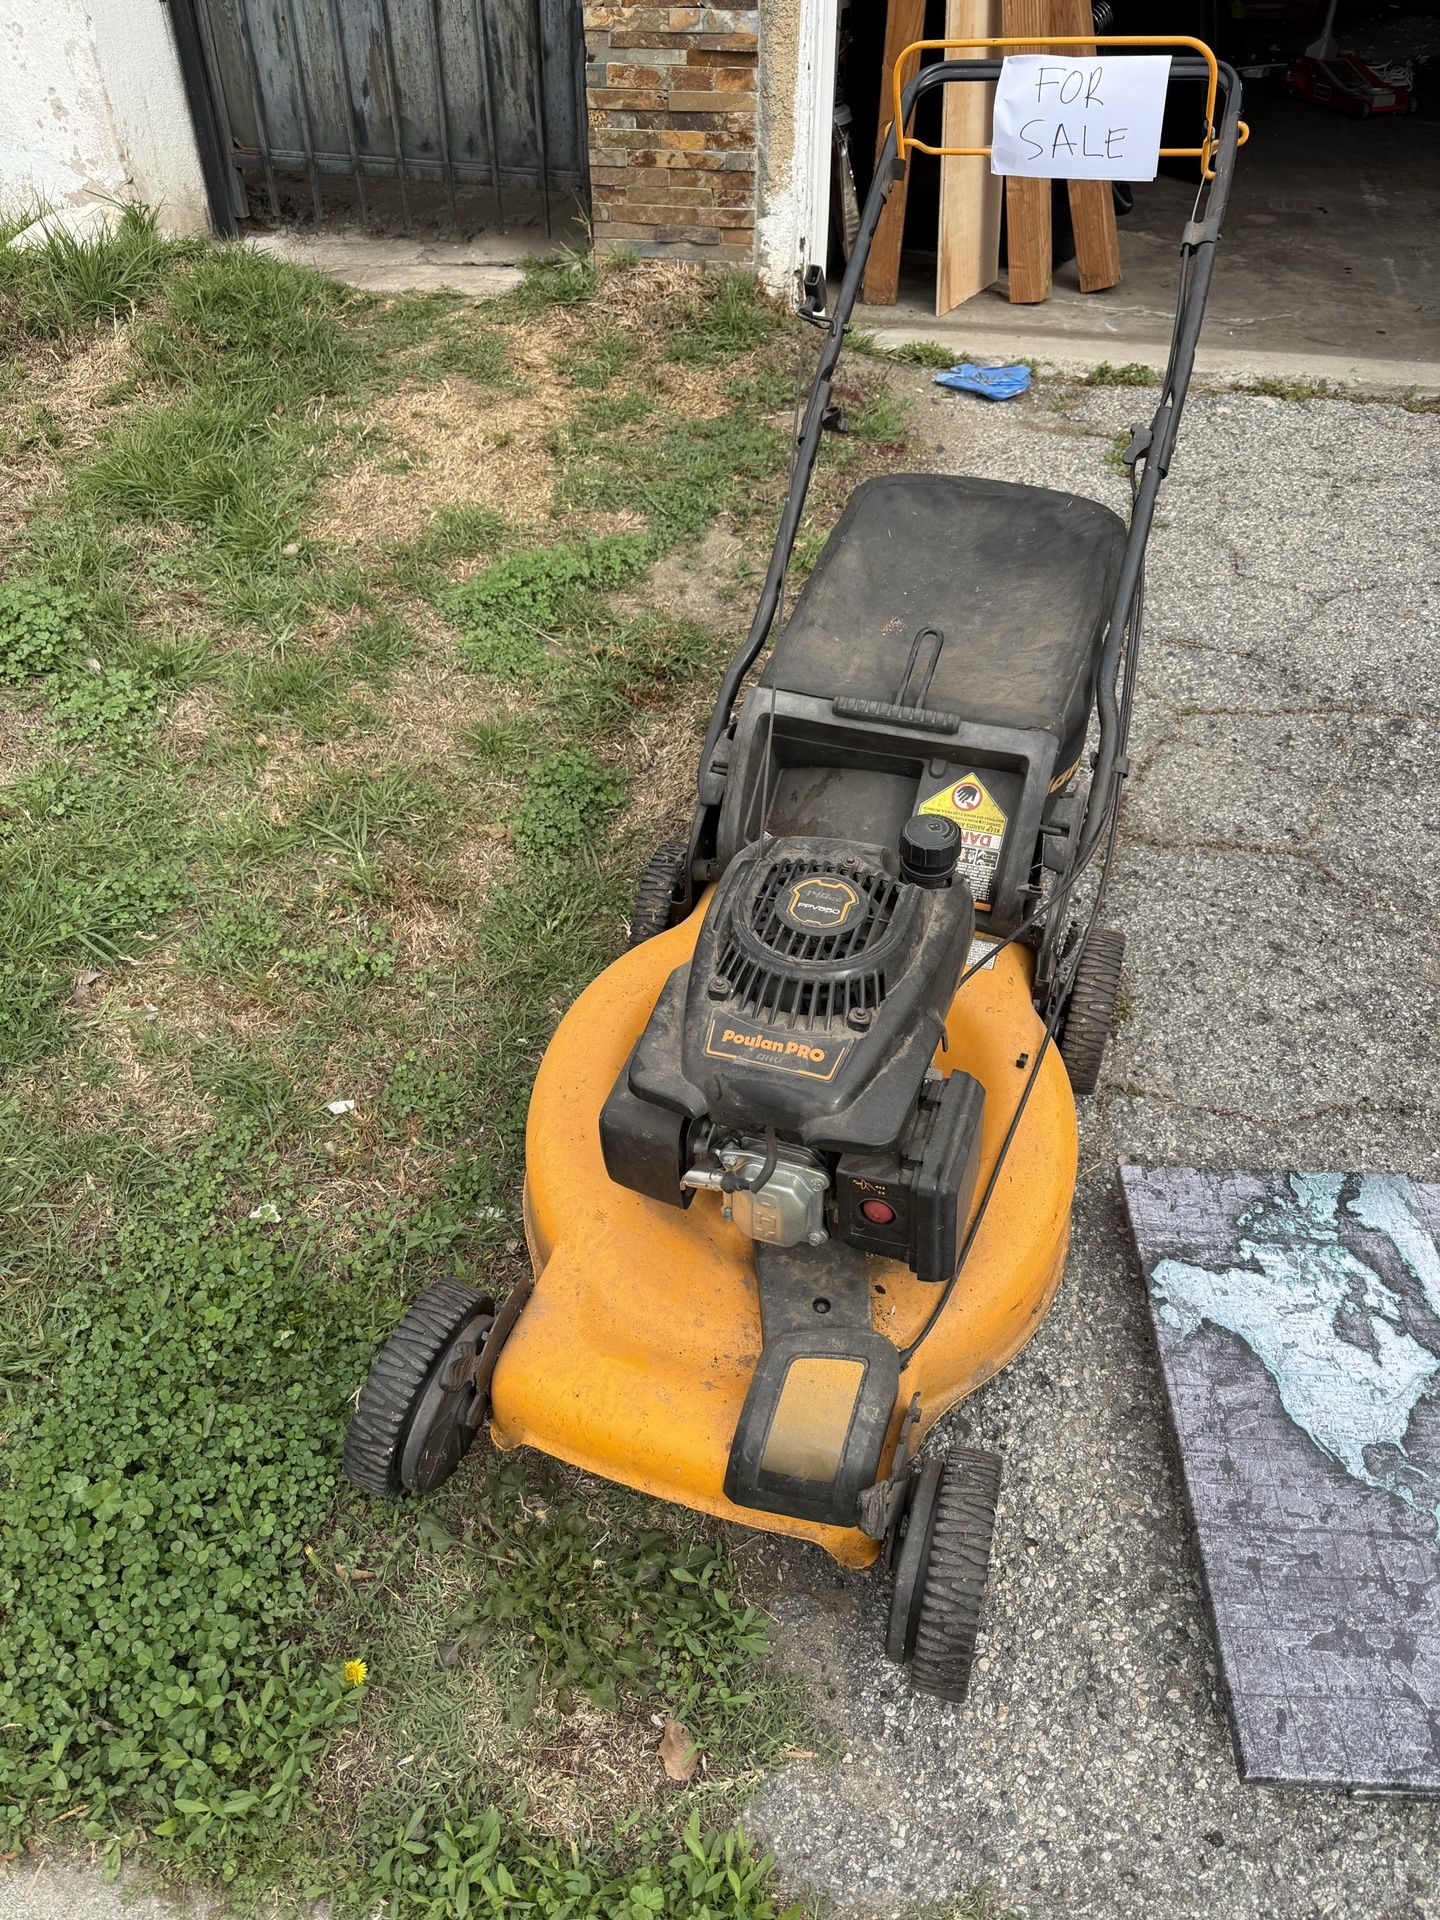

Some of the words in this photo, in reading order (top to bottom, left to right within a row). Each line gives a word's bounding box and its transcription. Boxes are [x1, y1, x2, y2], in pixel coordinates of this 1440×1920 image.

[1035, 66, 1104, 108] FOR
[1019, 119, 1128, 161] SALE
[960, 831, 992, 848] DAN
[721, 1029, 784, 1053] Poulan
[784, 1040, 826, 1062] PRO
